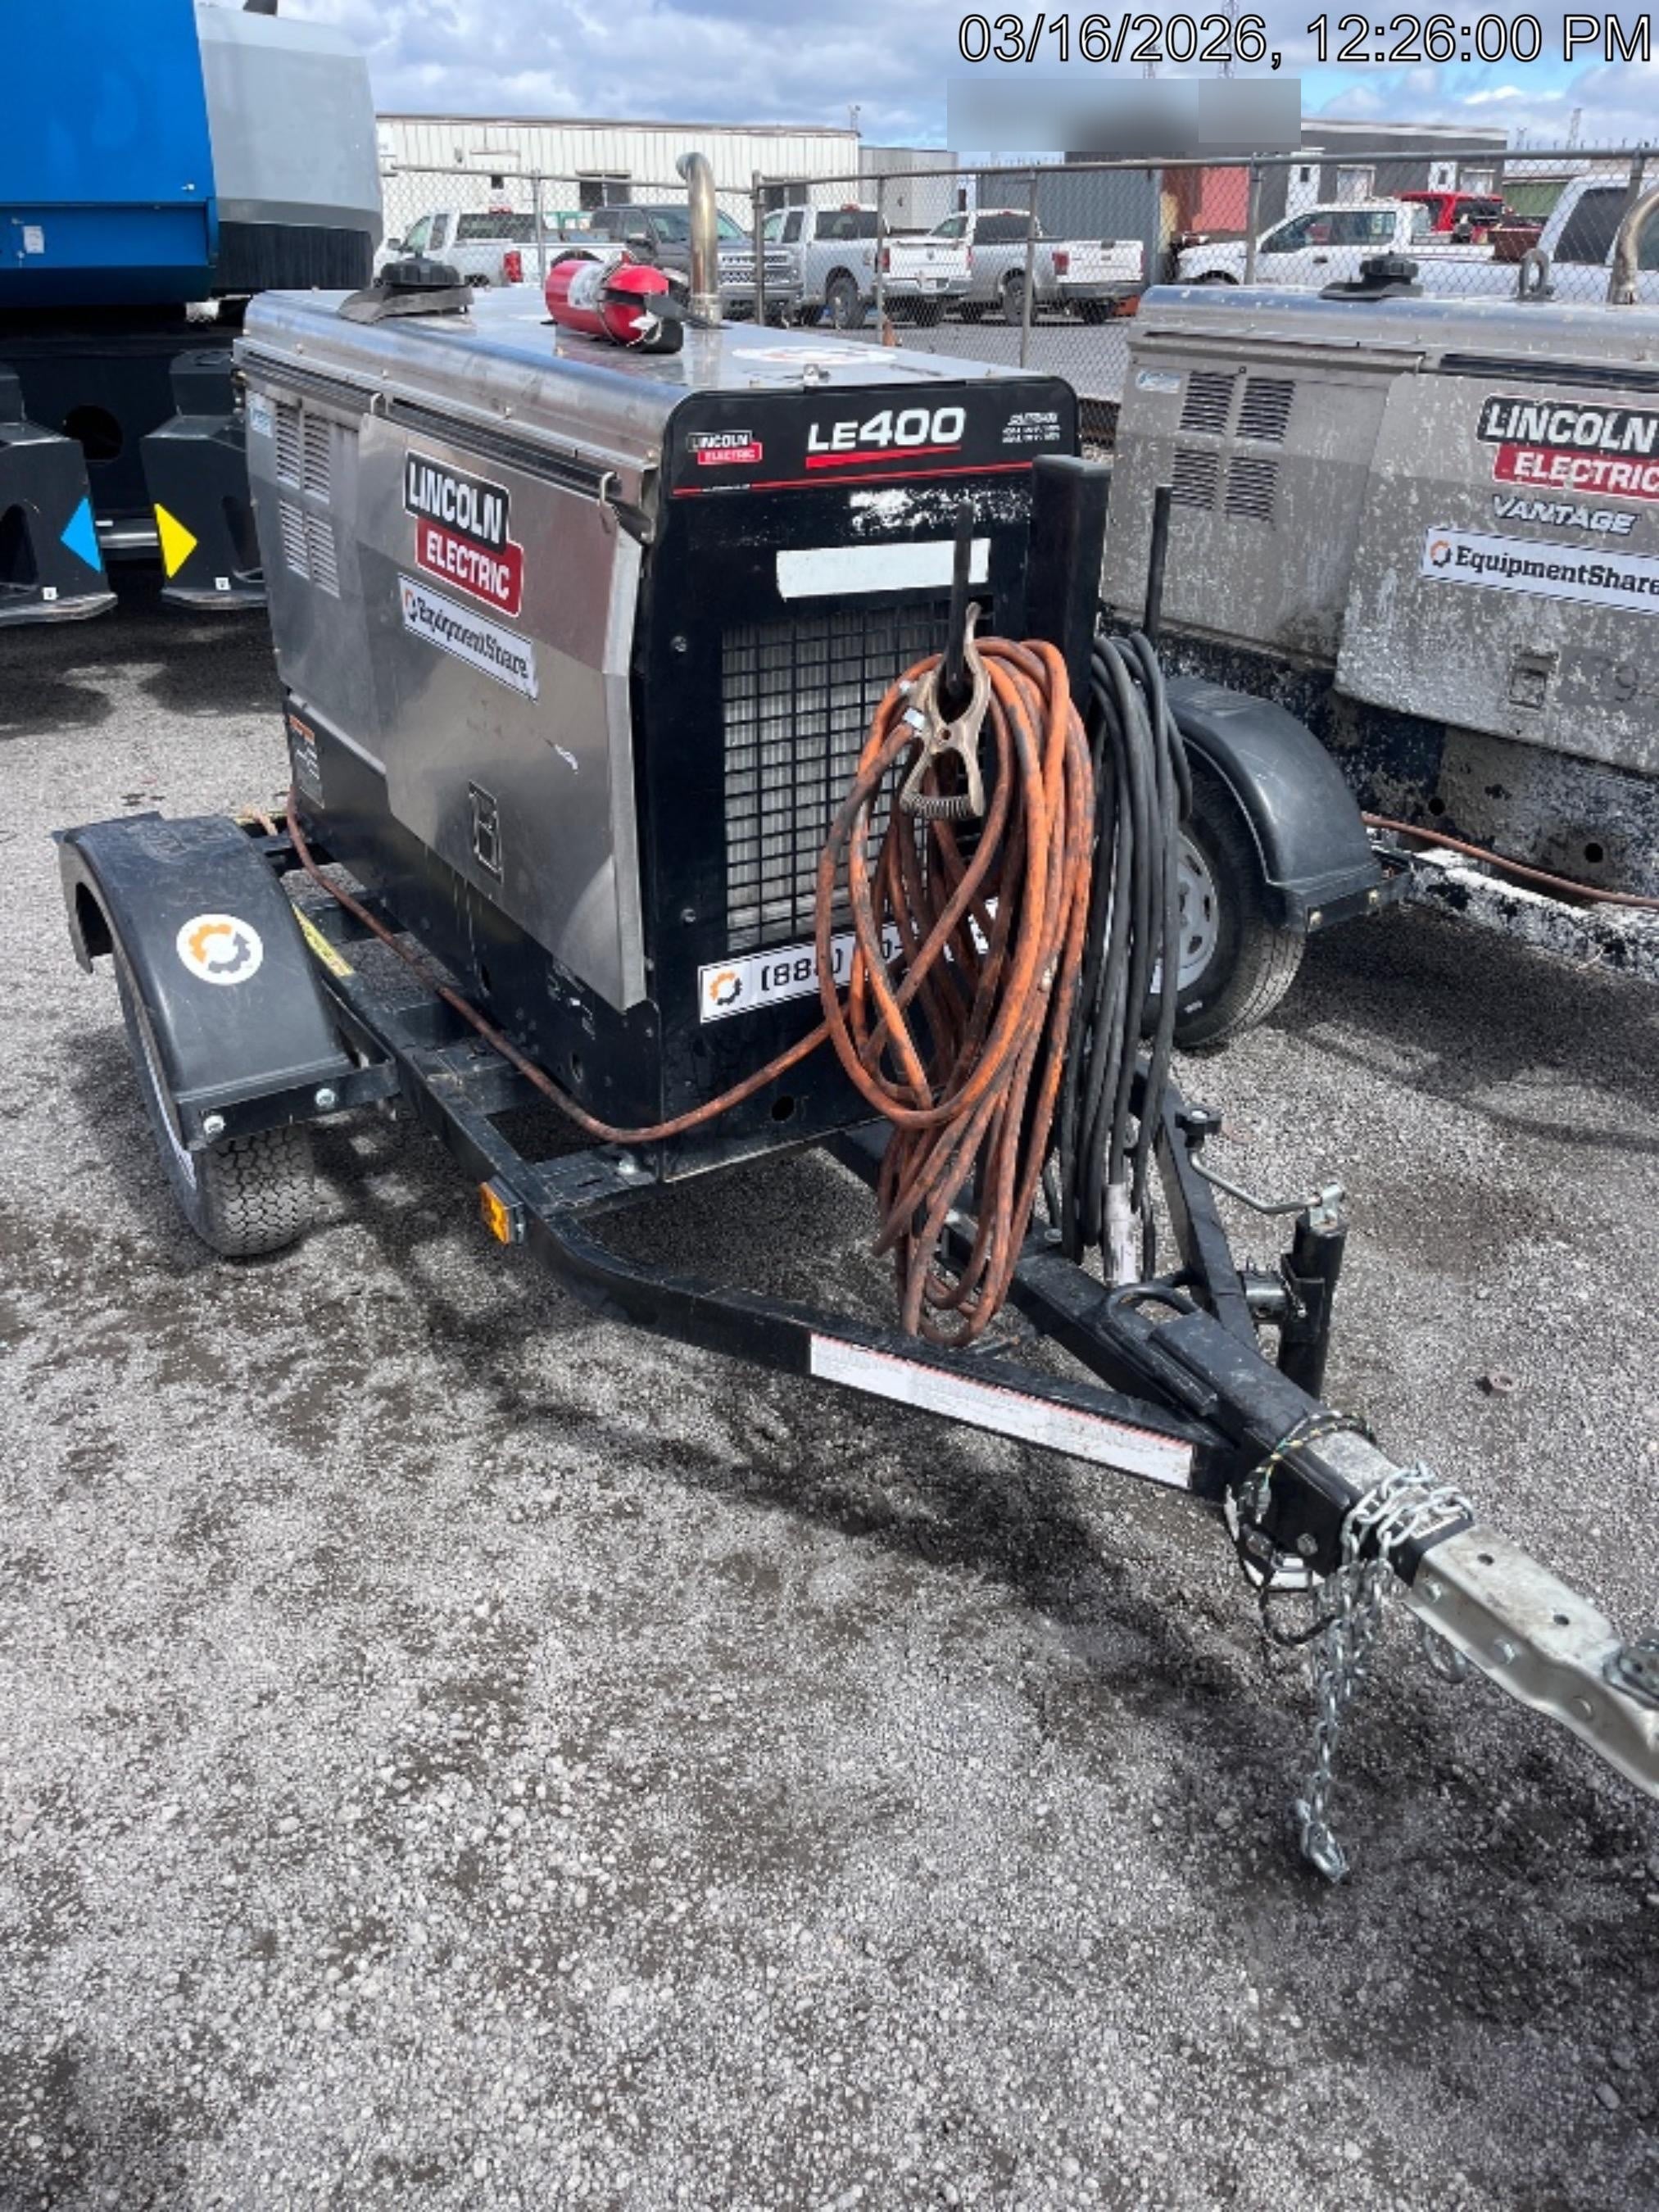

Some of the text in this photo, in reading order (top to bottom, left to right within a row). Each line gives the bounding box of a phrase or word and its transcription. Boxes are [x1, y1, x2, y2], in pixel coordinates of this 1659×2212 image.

[691, 434, 749, 448] LINCOLN
[807, 407, 966, 451] LE400
[1486, 403, 1657, 453] LINCOLN
[1513, 451, 1659, 492] ELECTRIC
[409, 462, 502, 544] LINCOLN
[1492, 494, 1639, 535] VANTAGE
[427, 529, 510, 600] ELECTRIC
[1455, 545, 1659, 596] EquipmentShare
[416, 596, 529, 679] EquipmentShare
[761, 948, 843, 990] (88)
